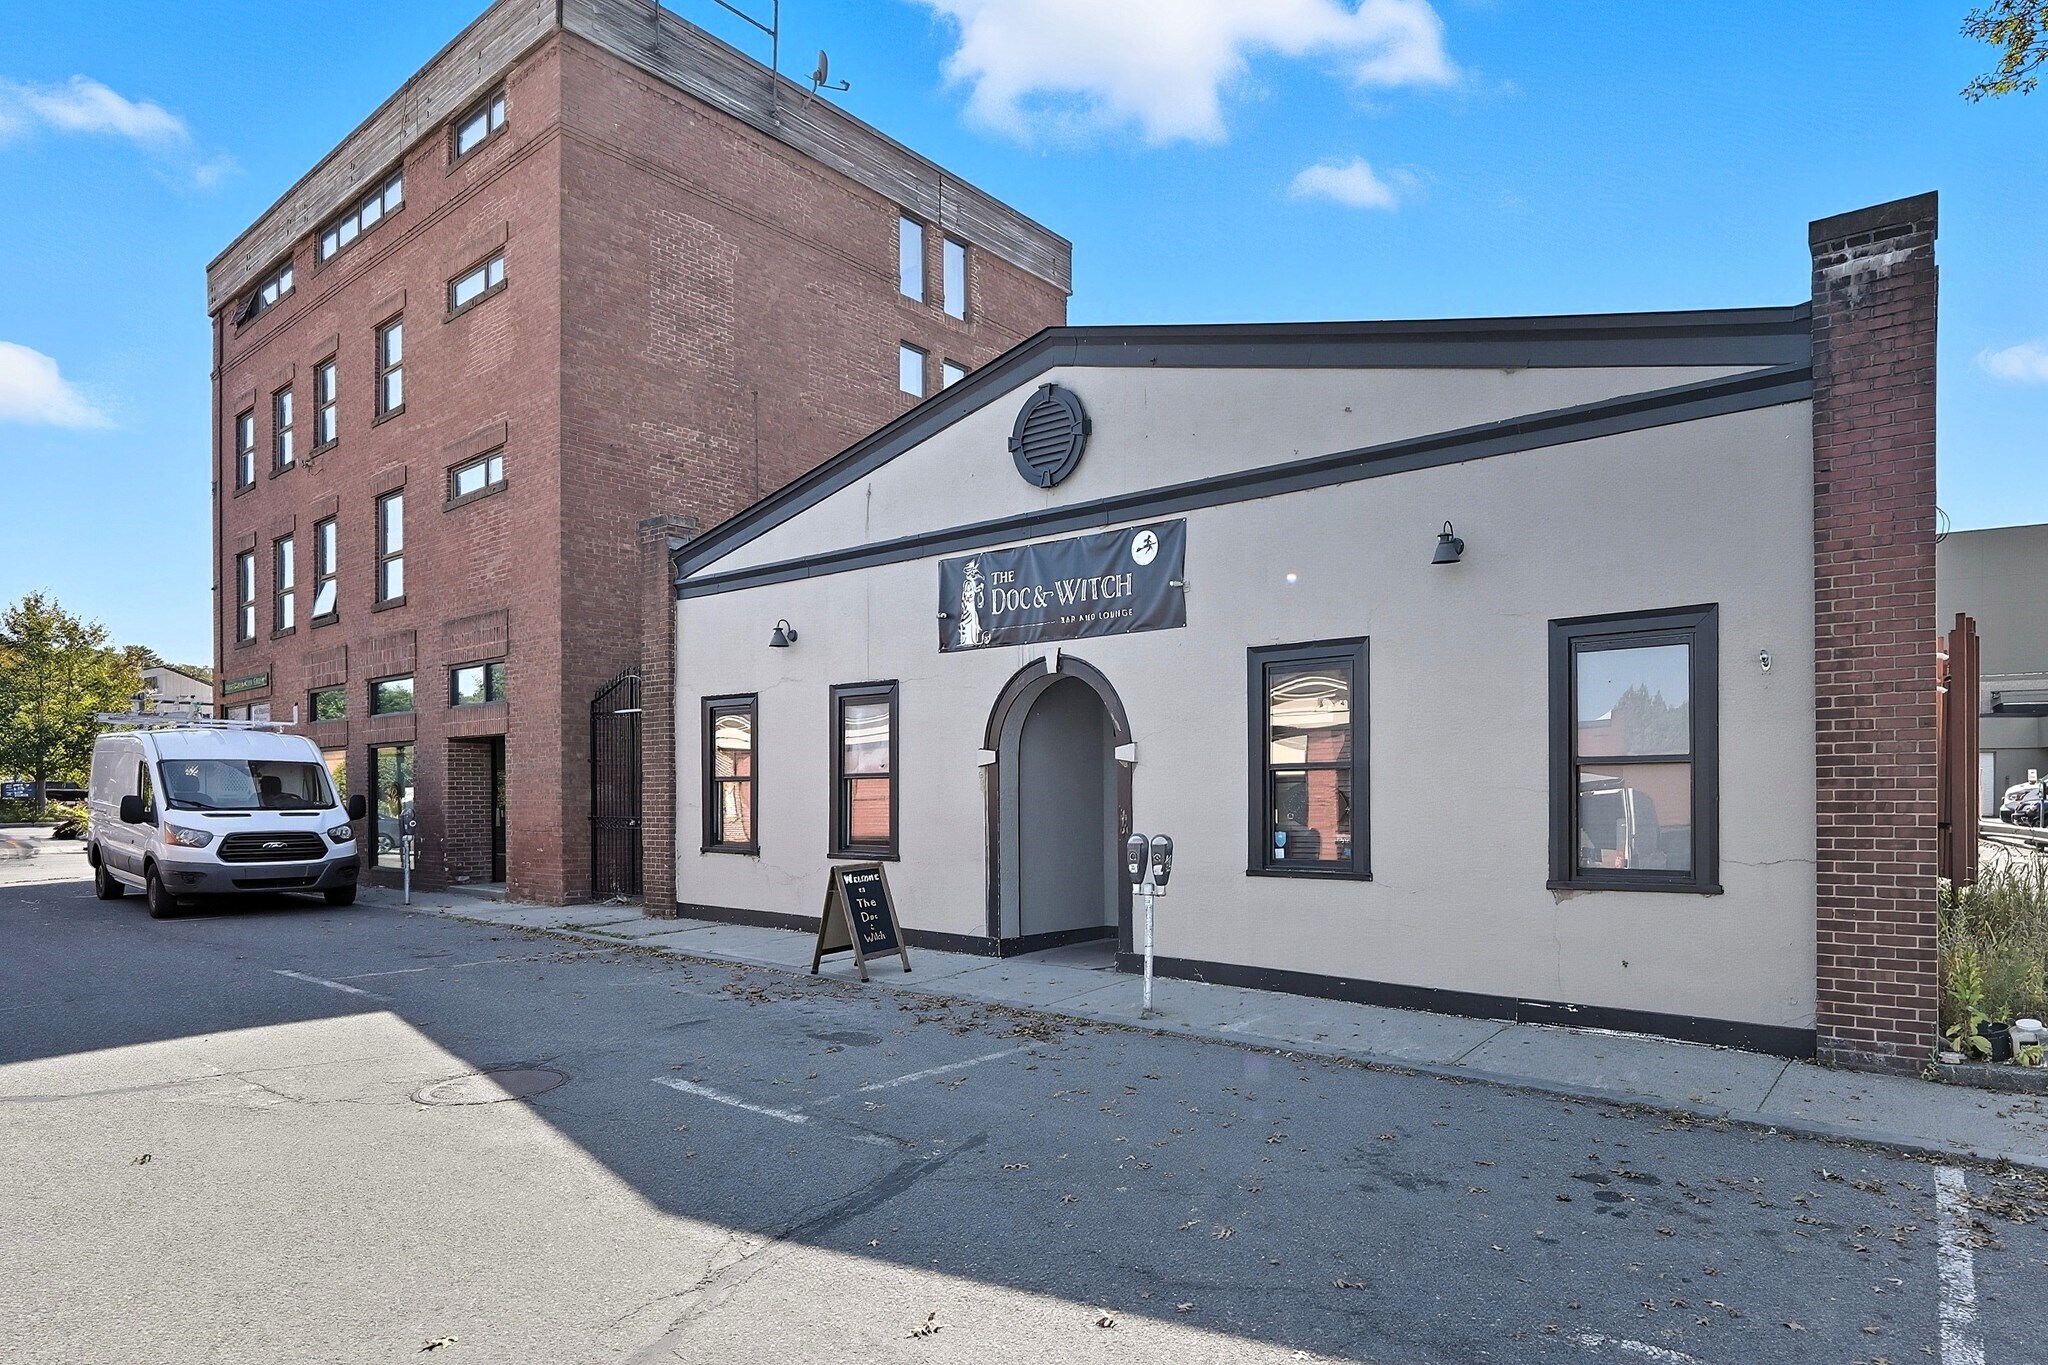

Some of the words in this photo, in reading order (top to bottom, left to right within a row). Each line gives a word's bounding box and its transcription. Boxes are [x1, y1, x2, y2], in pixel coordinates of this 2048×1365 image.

[991, 570, 1015, 585] THE
[991, 586, 1031, 615] DOC
[1033, 585, 1054, 608] &
[1054, 573, 1133, 606] WITCH
[1060, 615, 1076, 624] BAR
[1079, 613, 1096, 622] AND
[1098, 608, 1133, 620] LOUNGE
[856, 898, 877, 908] The
